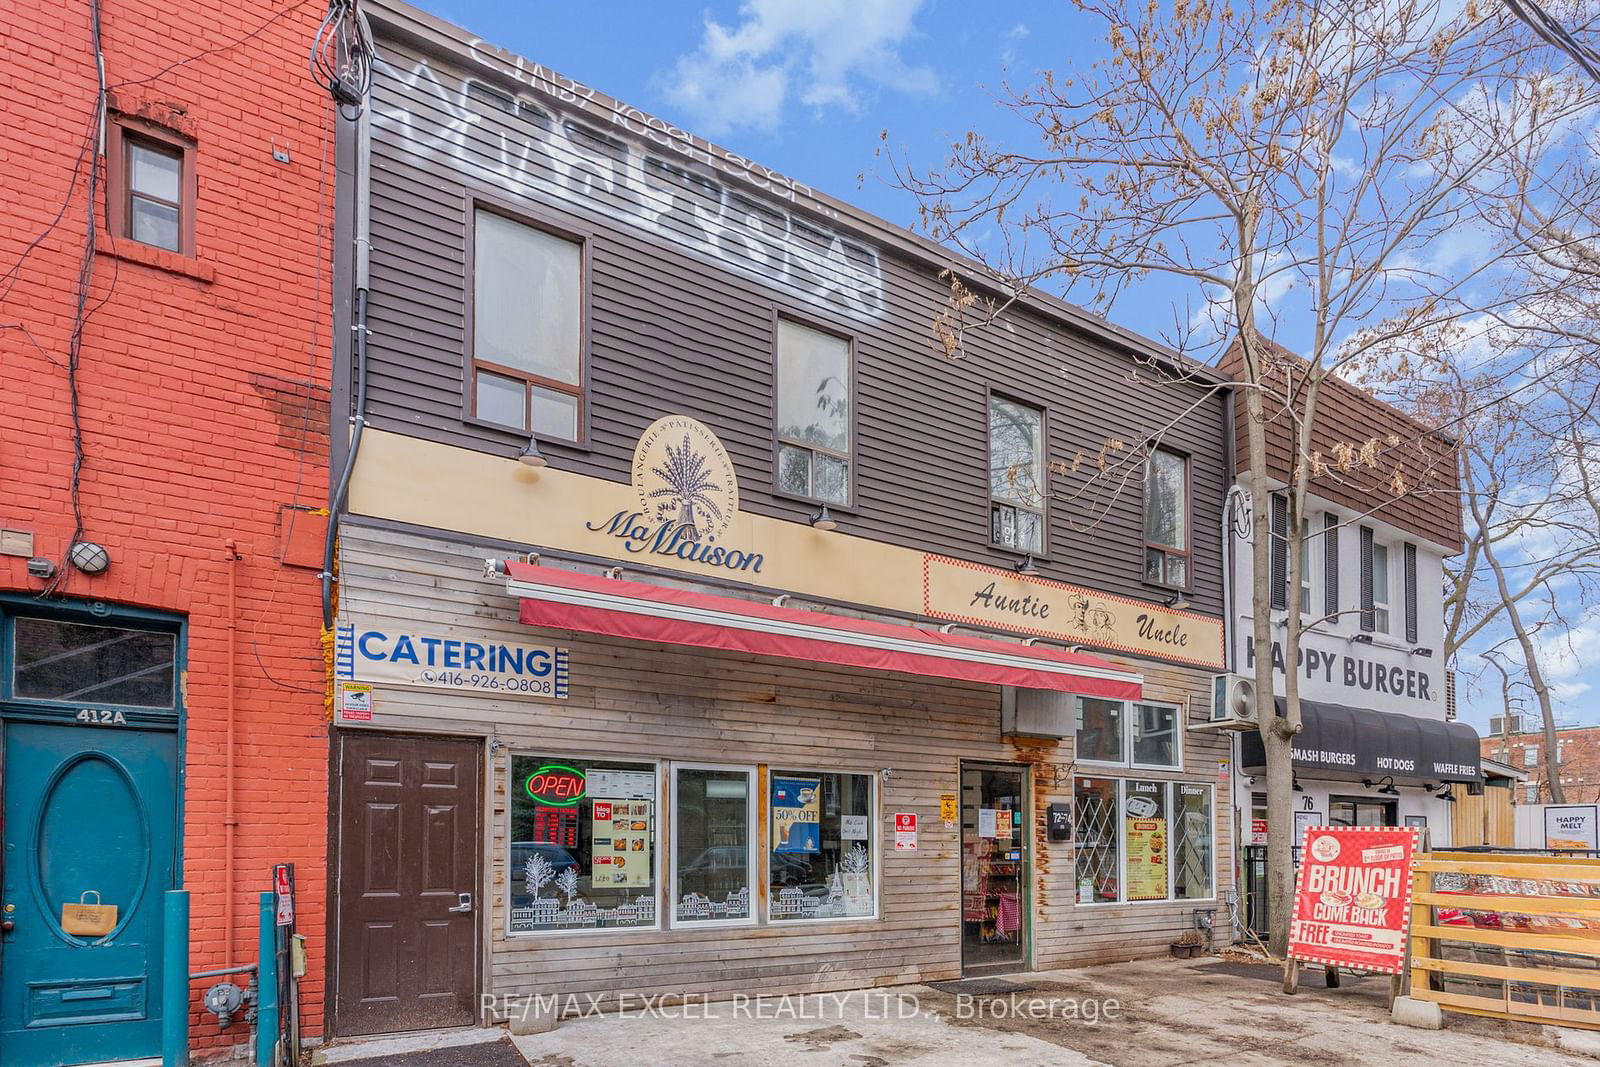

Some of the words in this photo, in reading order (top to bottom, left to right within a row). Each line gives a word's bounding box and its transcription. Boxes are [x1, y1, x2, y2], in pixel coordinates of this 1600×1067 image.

[721, 473, 735, 529] TRAITEUR
[969, 582, 1049, 618] Auntie
[1136, 613, 1188, 646] Uncle
[358, 631, 552, 677] CATERING
[438, 671, 551, 694] 416-926-0808
[1344, 656, 1431, 701] BURGER
[77, 709, 127, 725] 412A
[1320, 750, 1356, 766] BURGERS
[1377, 757, 1393, 769] HOT
[1394, 759, 1415, 772] DOGS
[1434, 762, 1459, 775] WAFFLE
[1459, 764, 1476, 776] FRIES
[530, 775, 584, 797] OPEN
[1135, 782, 1157, 793] Lunch
[1180, 785, 1203, 795] Dinner
[775, 809, 797, 820] 50%
[798, 810, 818, 821] OFF
[1302, 796, 1314, 810] 76
[1308, 864, 1402, 899] BRUNCH
[1313, 902, 1350, 923] COME
[1350, 906, 1388, 927] BACK
[1299, 922, 1330, 945] FREE
